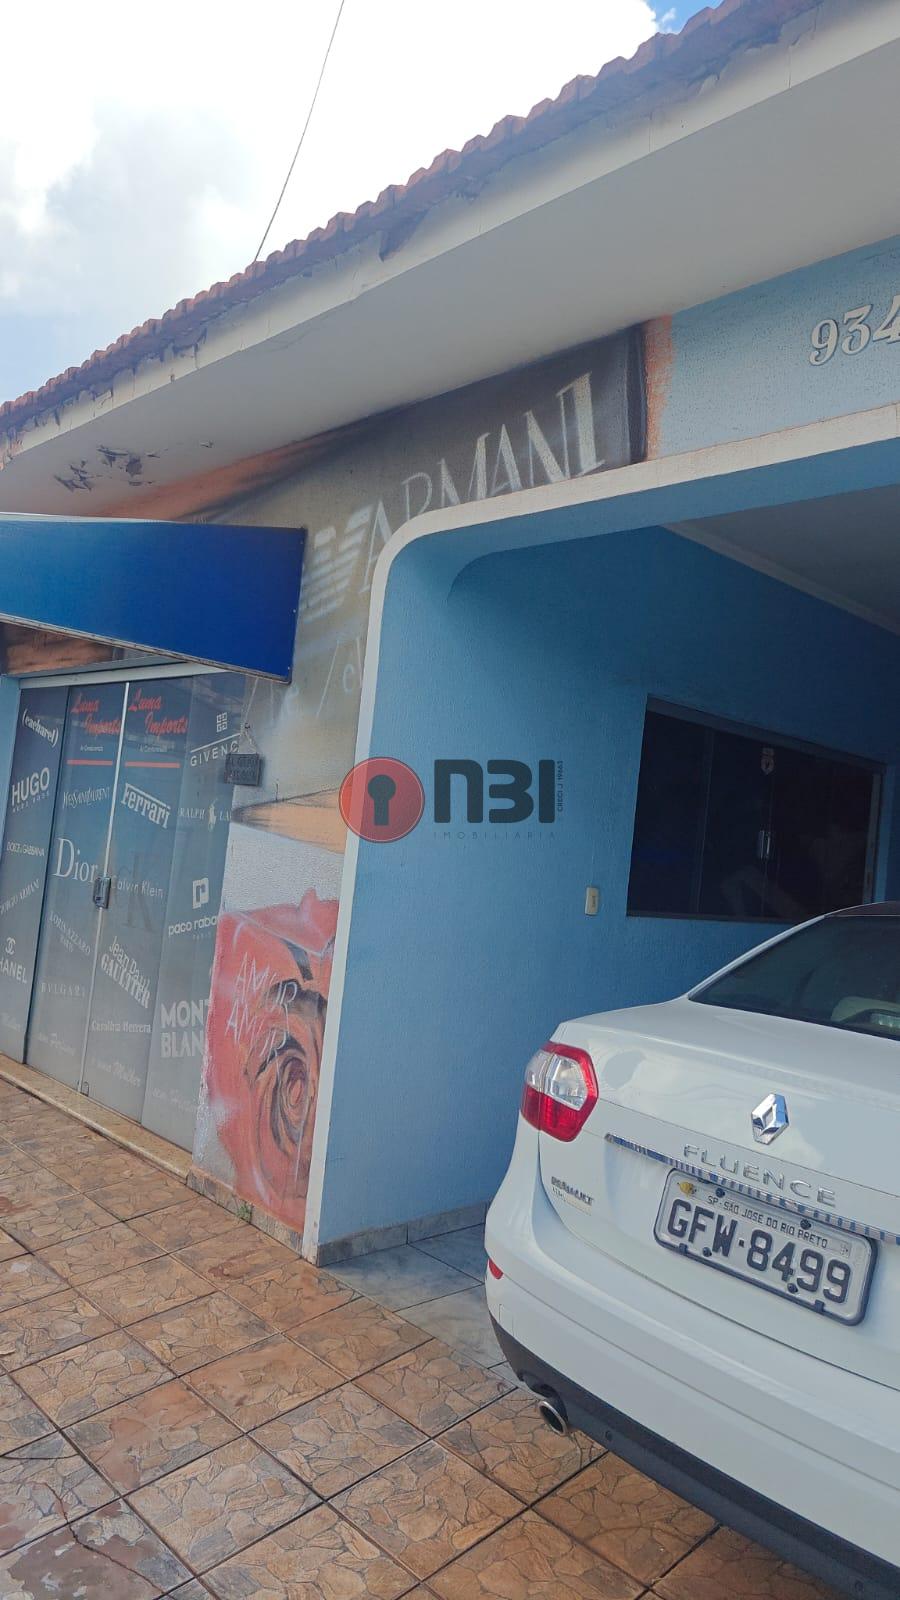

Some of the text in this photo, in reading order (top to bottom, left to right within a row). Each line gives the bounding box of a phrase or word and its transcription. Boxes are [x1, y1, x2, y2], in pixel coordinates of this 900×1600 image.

[12, 767, 50, 806] HUGO
[120, 782, 171, 829] Ferrari
[52, 837, 98, 883] Dior
[168, 921, 192, 936] paco
[683, 1143, 837, 1208] FLUENCE
[667, 1198, 852, 1304] GFW-8499
[741, 1208, 764, 1224] JOSE
[766, 1216, 778, 1229] DO
[780, 1222, 796, 1236] RIO
[797, 1228, 828, 1249] PRETO
